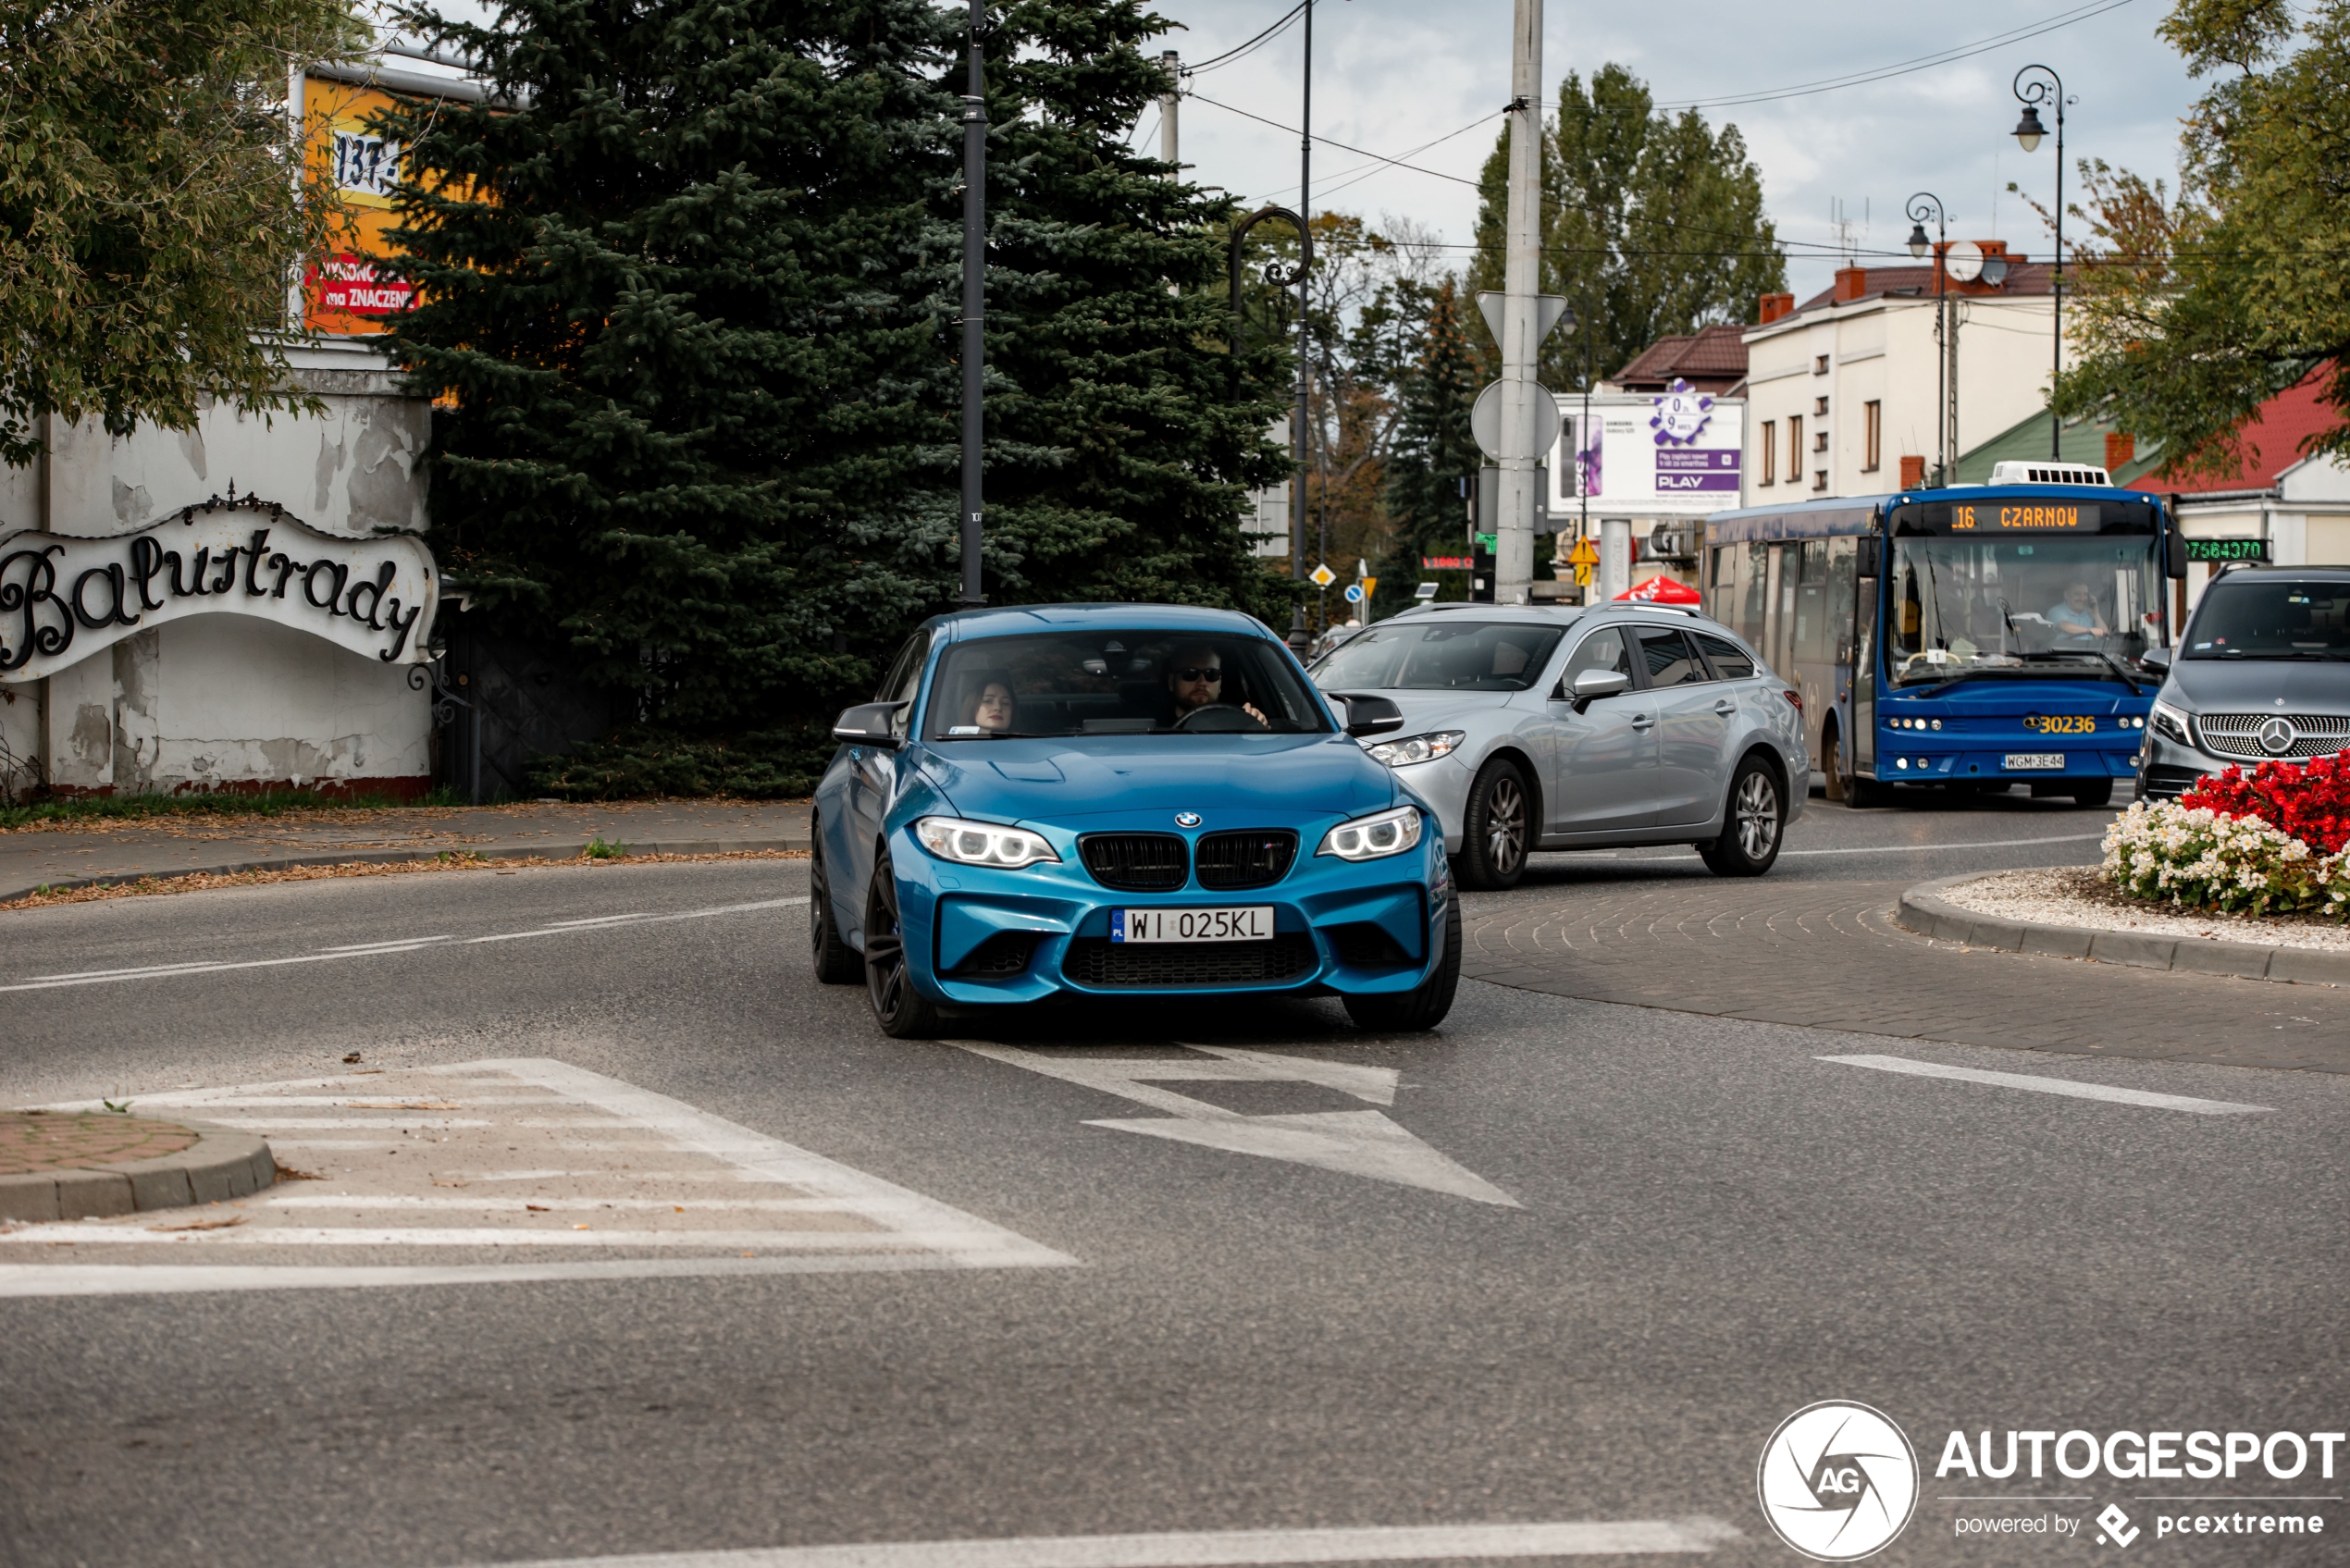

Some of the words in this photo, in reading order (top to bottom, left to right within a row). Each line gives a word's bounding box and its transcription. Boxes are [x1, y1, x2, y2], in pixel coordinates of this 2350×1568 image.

[327, 292, 346, 305] ma
[1673, 398, 1680, 412] 0
[1668, 416, 1676, 430] 9
[1658, 475, 1703, 488] PLAY
[1951, 506, 1975, 528] 16
[0, 529, 421, 671] Balustrady
[2039, 715, 2096, 734] 30236
[2008, 756, 2032, 767] WGM
[2036, 756, 2062, 767] 3E44
[1180, 910, 1266, 938] 025KL
[1113, 929, 1123, 937] PL
